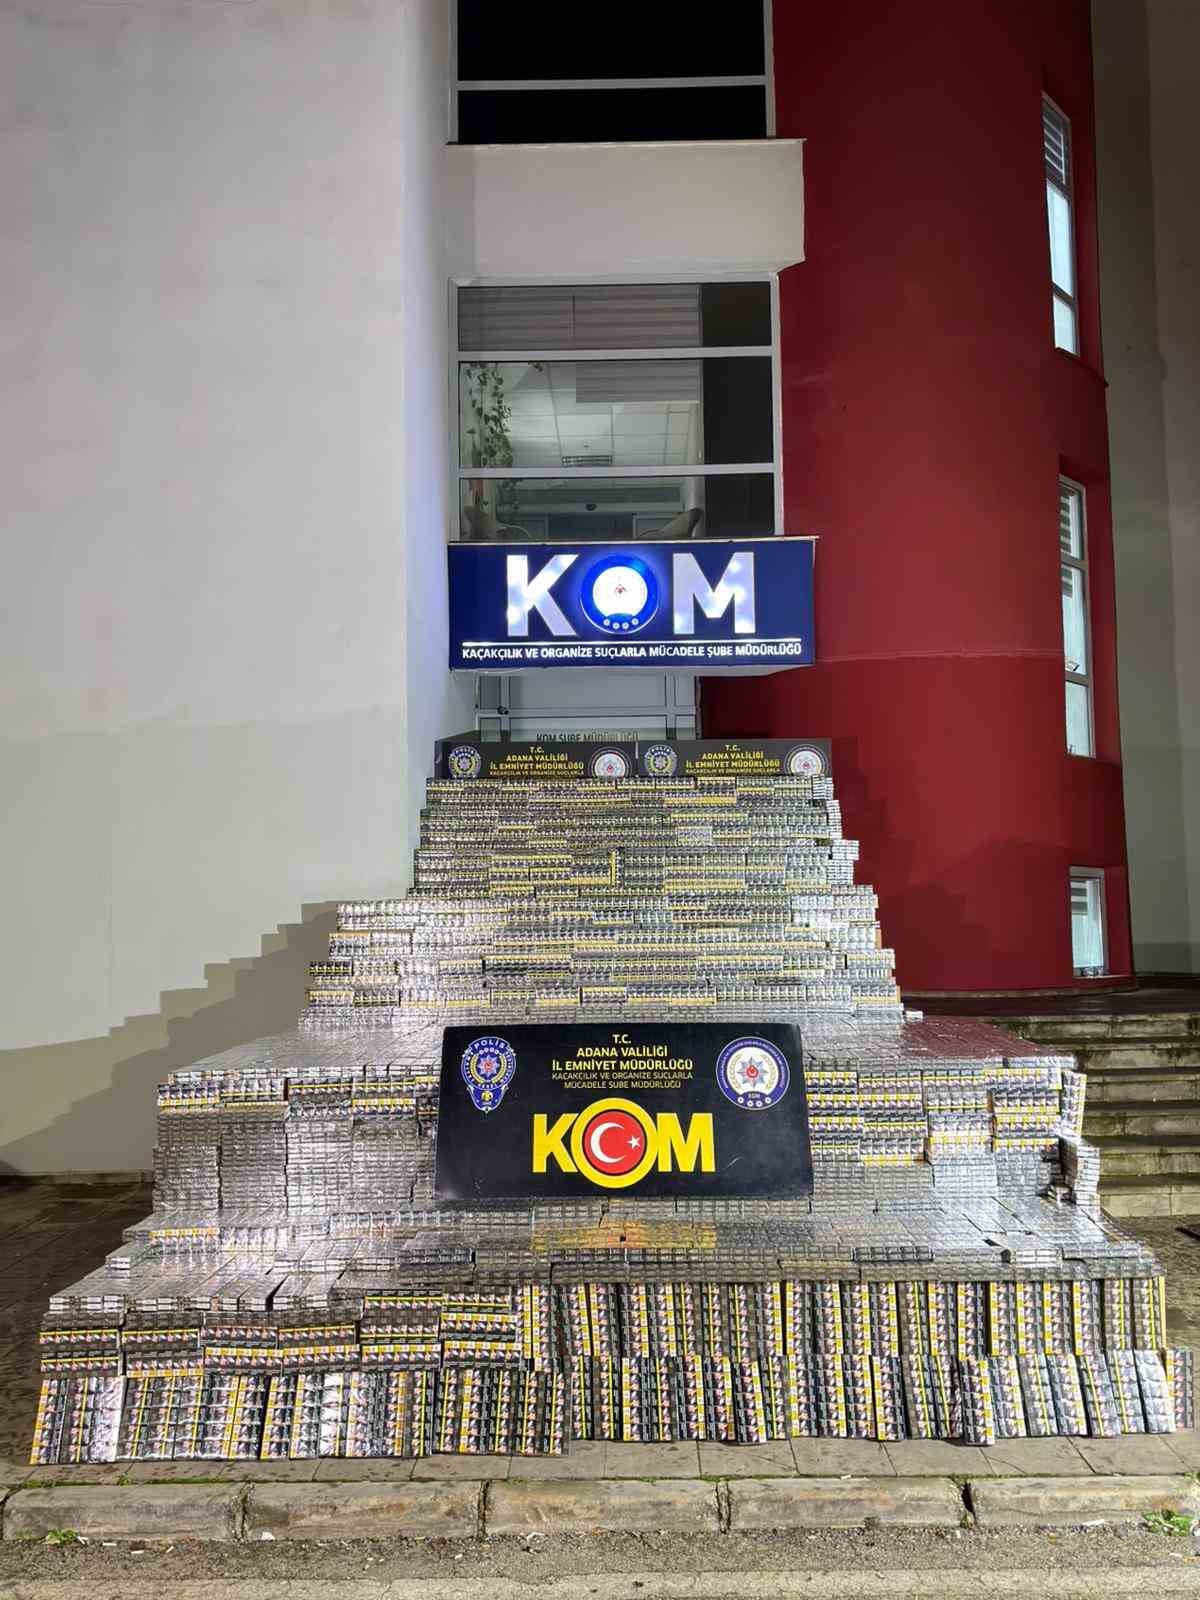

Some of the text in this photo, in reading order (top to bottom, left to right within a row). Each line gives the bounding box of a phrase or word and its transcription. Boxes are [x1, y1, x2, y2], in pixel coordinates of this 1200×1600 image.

[507, 552, 756, 637] KOM
[462, 643, 802, 660] KAÇAKÇILIK VE ORGANİZE SUÇLARLA MÜCADELE ŞUBE MÜDÜRLÜĞÜ
[612, 1034, 632, 1044] T.C.
[576, 1045, 668, 1057] ADANA VALİLİĞİ
[552, 1058, 693, 1071] İL EMNİYET MÜDÜRLÜĞÜ
[532, 1097, 716, 1189] KOM
